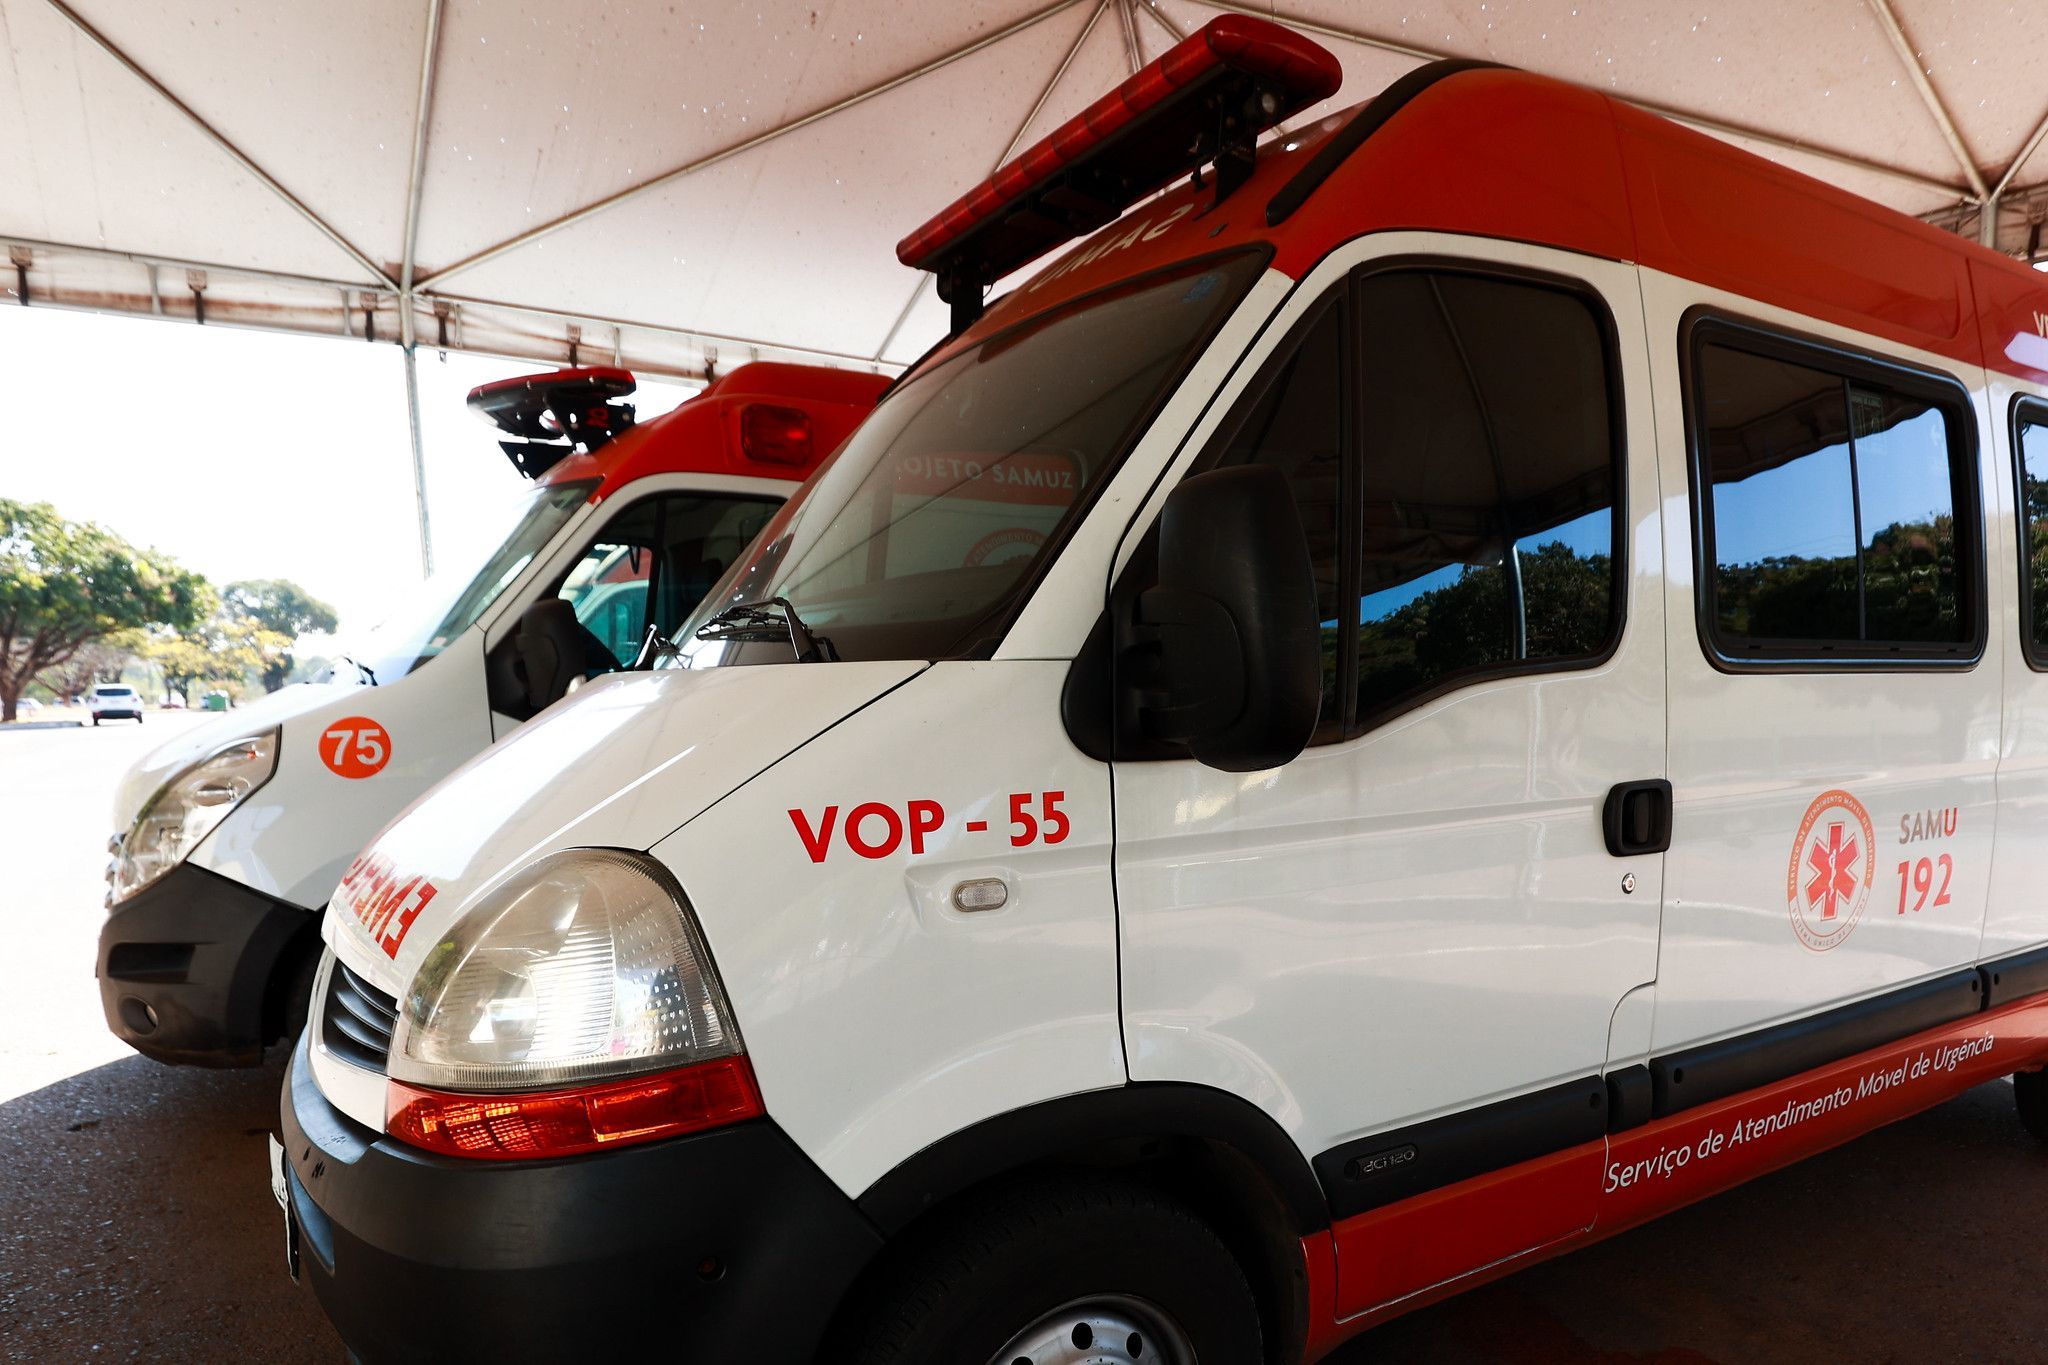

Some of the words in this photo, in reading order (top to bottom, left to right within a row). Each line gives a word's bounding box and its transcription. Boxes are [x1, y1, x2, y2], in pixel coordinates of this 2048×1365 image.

[326, 728, 383, 766] 75
[787, 799, 945, 864] VOP
[966, 820, 988, 832] -
[1009, 791, 1070, 847] 55
[1898, 807, 1958, 845] SAMU
[1897, 853, 1953, 915] 192
[1605, 1143, 1691, 1194] Serviço
[1696, 1128, 1723, 1159] de
[1728, 1086, 1852, 1149] Atendimento
[1855, 1057, 1909, 1103] Móvel
[1909, 1051, 1929, 1081] de
[1932, 1031, 1994, 1072] Urgência
[1390, 1150, 1415, 1165] 120
